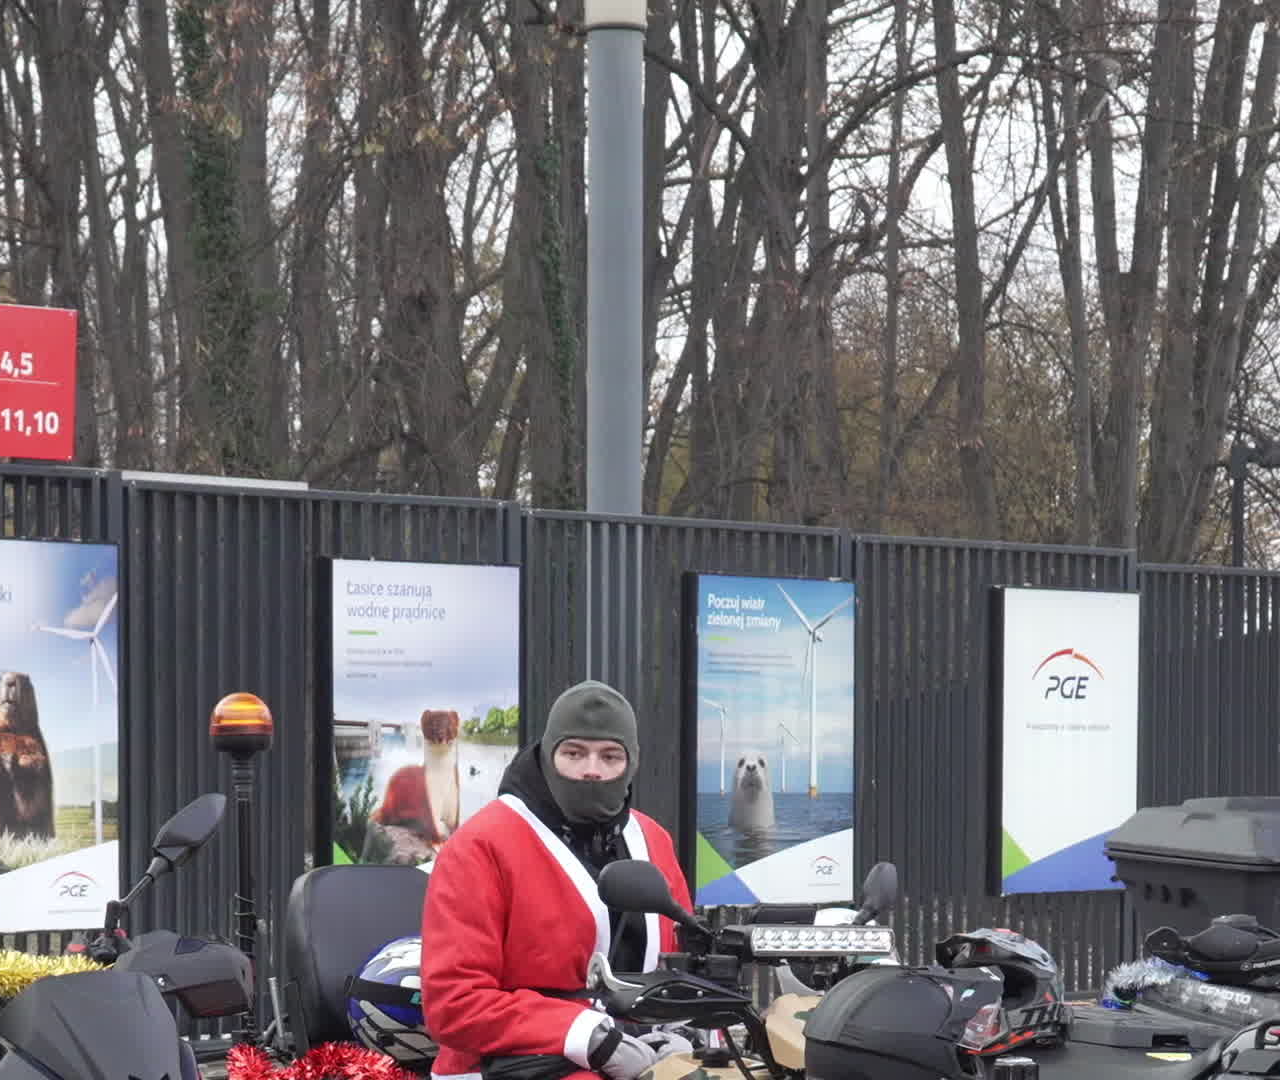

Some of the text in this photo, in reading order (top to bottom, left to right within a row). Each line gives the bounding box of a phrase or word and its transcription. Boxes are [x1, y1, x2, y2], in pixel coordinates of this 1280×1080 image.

[346, 601, 447, 624] wodne prądnice
[707, 593, 766, 613] Poczuj wiatr
[706, 611, 745, 630] zielonej
[1043, 676, 1089, 700] PGE
[59, 884, 89, 897] PGE
[1198, 984, 1253, 1005] CFMOTO
